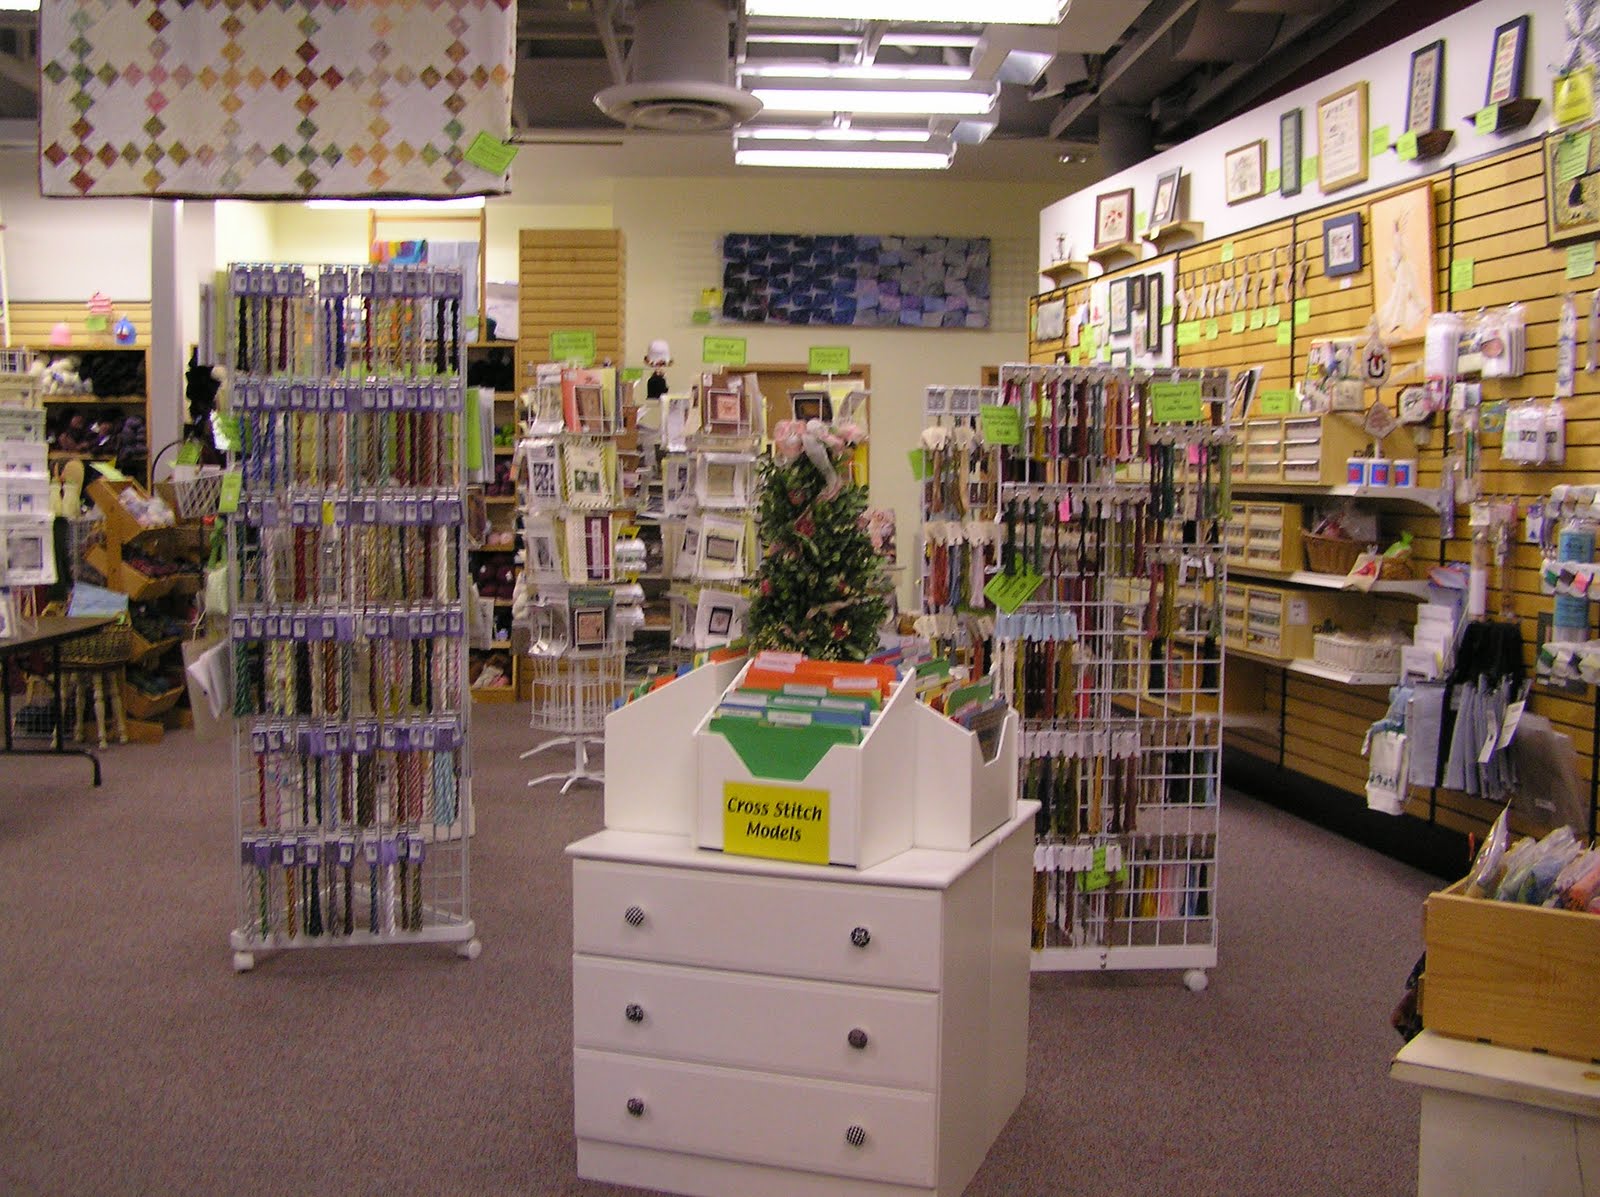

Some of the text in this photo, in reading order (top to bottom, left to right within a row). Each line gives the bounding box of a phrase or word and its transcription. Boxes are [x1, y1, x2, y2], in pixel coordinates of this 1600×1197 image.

[727, 797, 822, 821] Cross Stitch
[746, 821, 801, 842] Models
